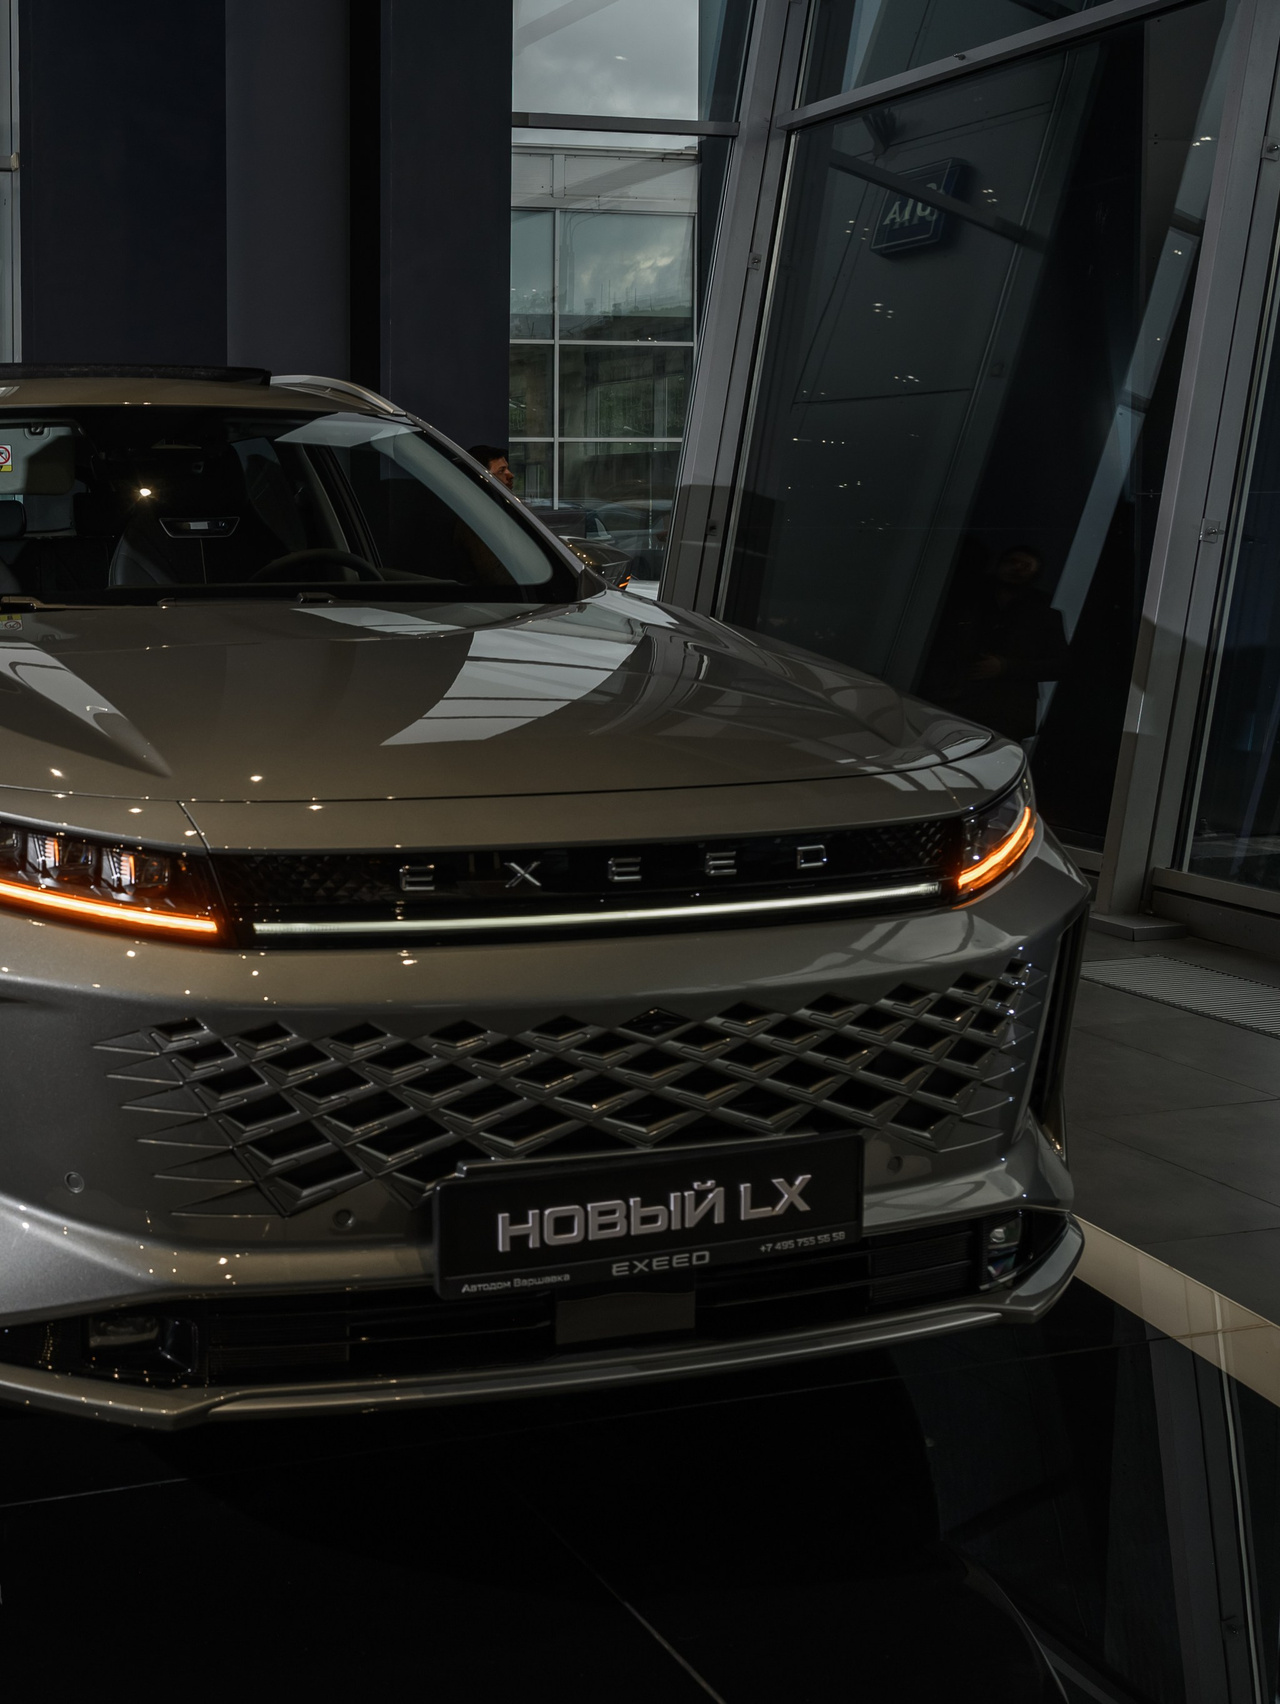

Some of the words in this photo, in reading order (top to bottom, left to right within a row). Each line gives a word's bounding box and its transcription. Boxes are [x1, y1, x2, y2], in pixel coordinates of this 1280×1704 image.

[399, 844, 826, 891] EXEED
[497, 1180, 724, 1252] НОВЫЙ
[739, 1174, 811, 1222] LX
[759, 1243, 773, 1253] +7
[774, 1239, 794, 1250] 495
[795, 1236, 816, 1247] 755
[611, 1250, 711, 1277] EXEED
[461, 1281, 511, 1294] Автодом
[513, 1273, 571, 1288] Варшавка
